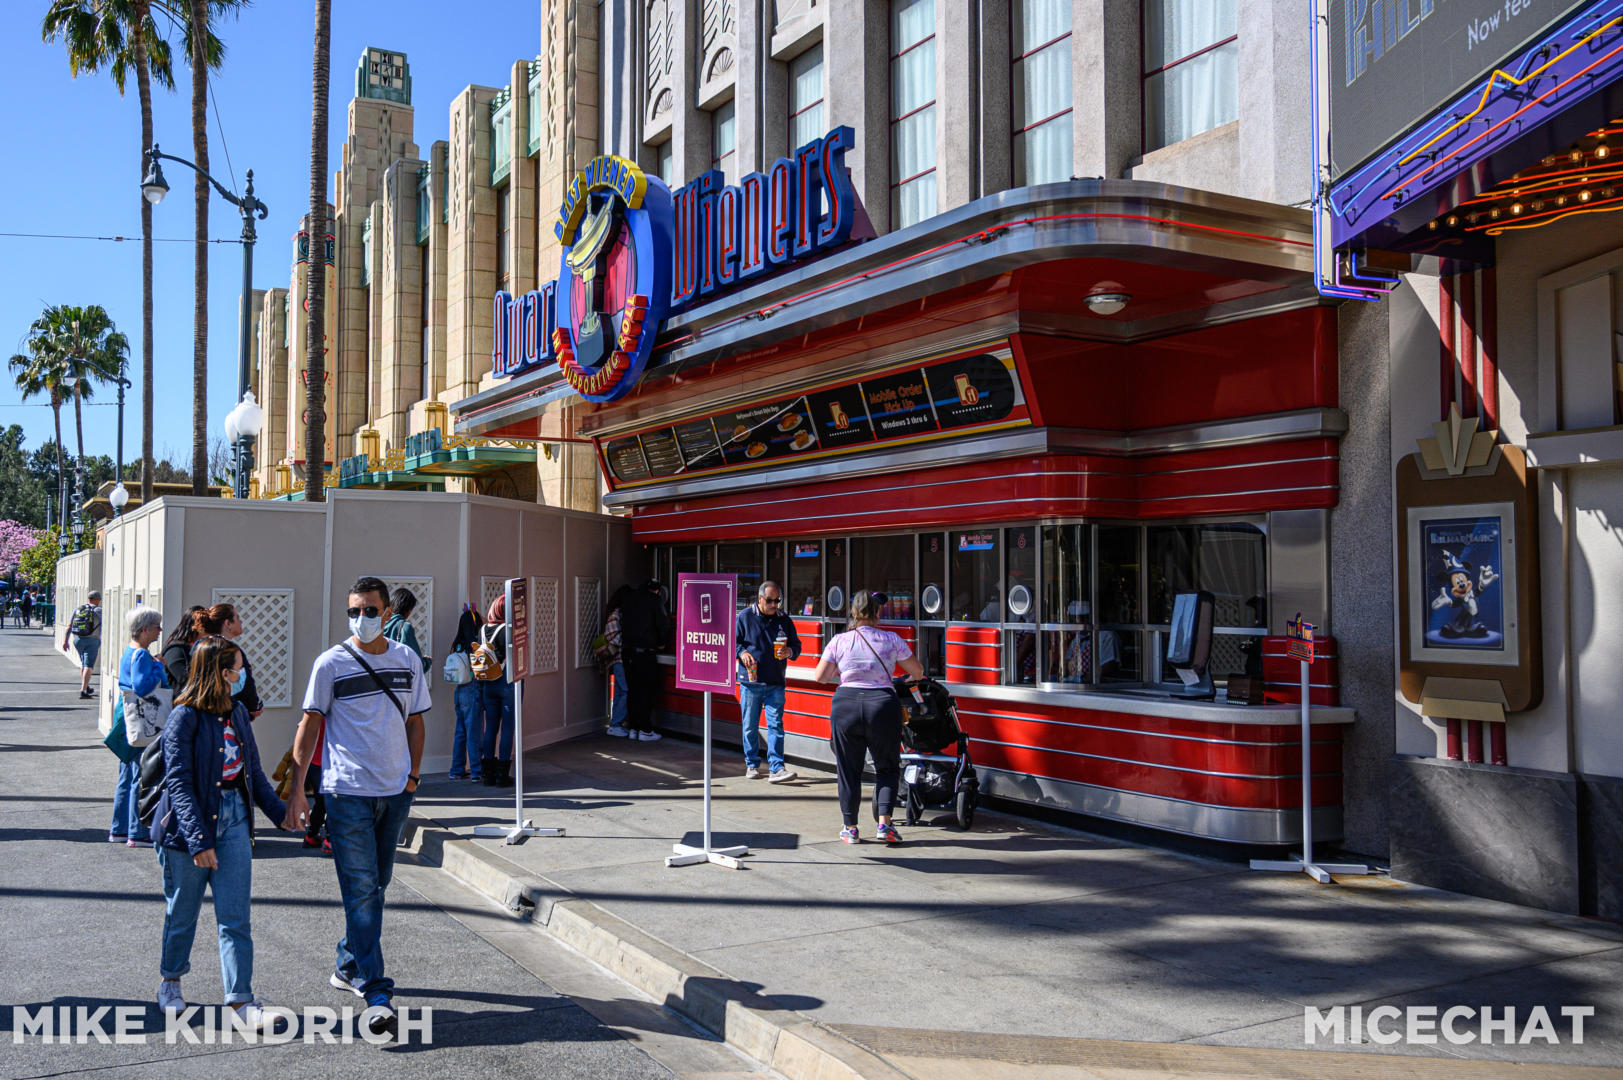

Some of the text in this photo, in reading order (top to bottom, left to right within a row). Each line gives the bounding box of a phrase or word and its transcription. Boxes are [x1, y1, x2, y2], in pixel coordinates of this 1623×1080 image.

[1467, 8, 1501, 50] Now
[553, 156, 636, 241] BEST WIENER
[492, 280, 557, 378] Awar
[671, 126, 855, 307] Wieners
[562, 351, 620, 393] SUPPORTING
[617, 295, 635, 352] ROLL
[869, 383, 923, 403] Mobile Order
[884, 399, 915, 414] Pick Up
[881, 419, 905, 430] Windows
[911, 416, 923, 425] thru
[1017, 533, 1026, 549] 6
[686, 631, 725, 646] RETURN
[693, 649, 718, 663] HERE
